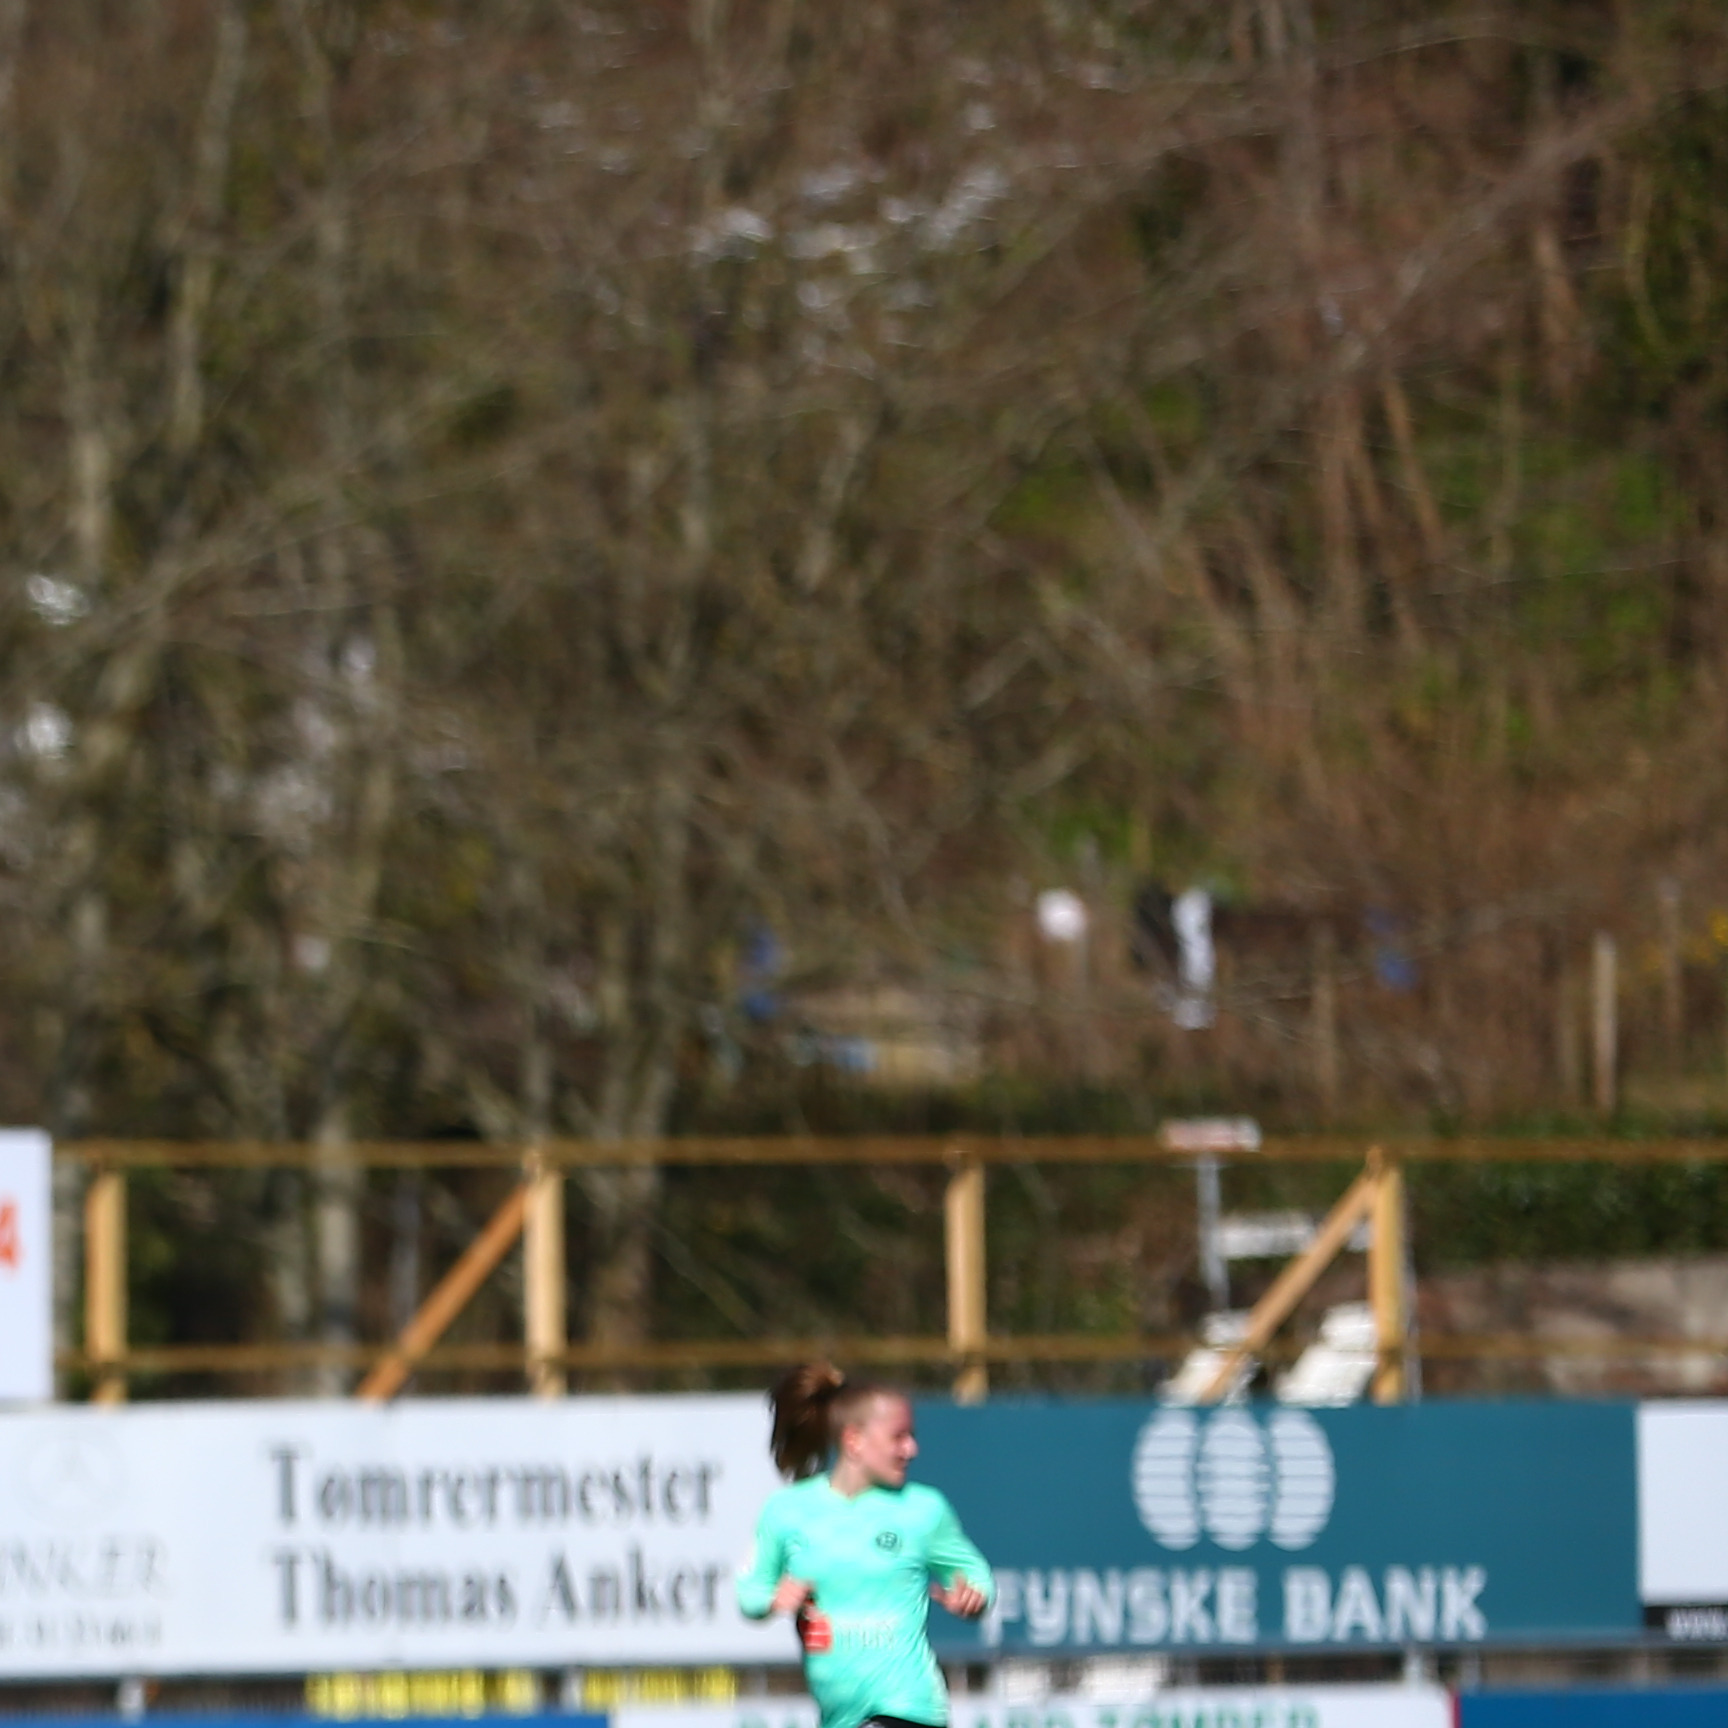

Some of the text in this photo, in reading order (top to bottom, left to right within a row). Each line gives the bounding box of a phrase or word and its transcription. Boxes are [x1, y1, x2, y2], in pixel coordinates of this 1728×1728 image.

[269, 1443, 724, 1530] Tømrermester
[270, 1543, 730, 1628] Thomas Anker
[982, 1563, 1260, 1648] FYNSKE
[1280, 1561, 1489, 1644] BANK
